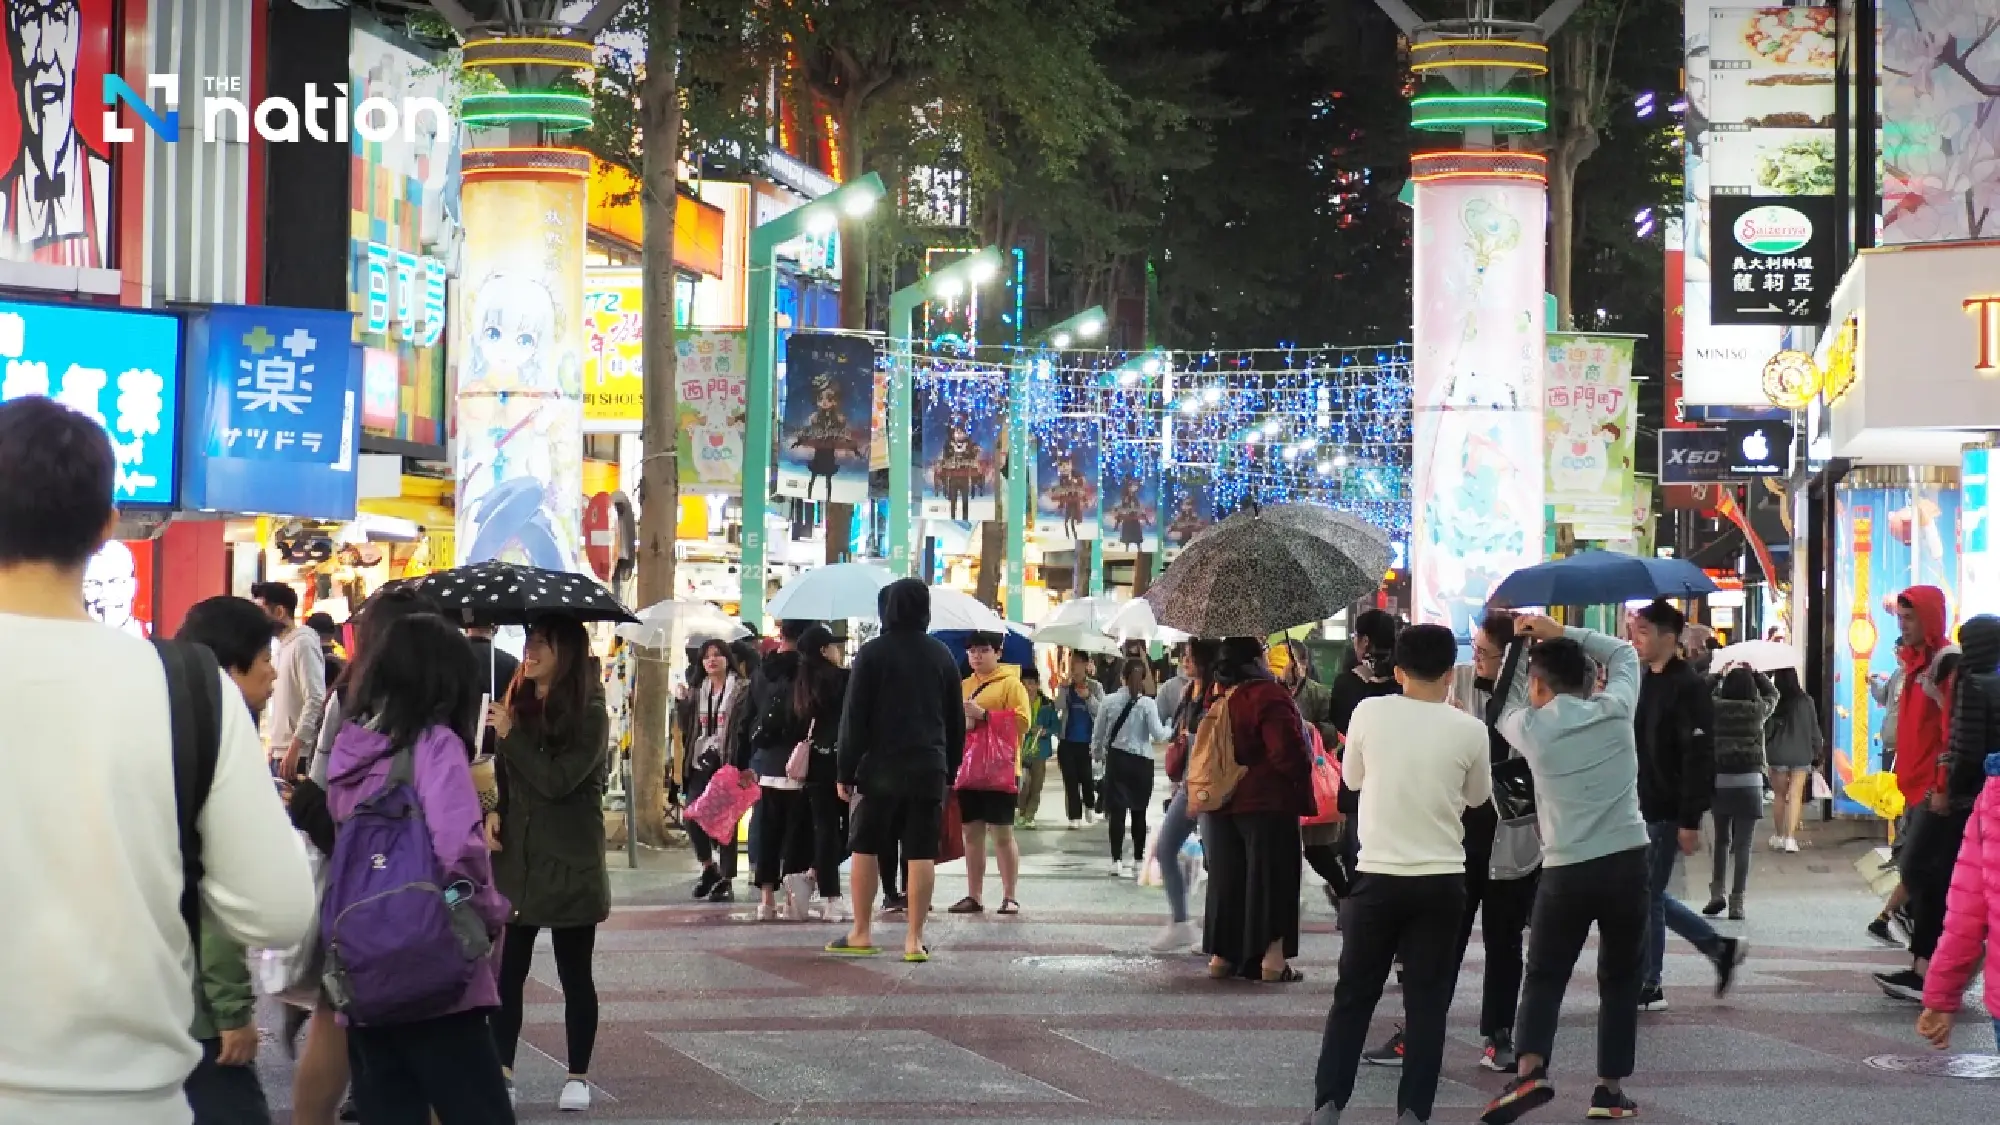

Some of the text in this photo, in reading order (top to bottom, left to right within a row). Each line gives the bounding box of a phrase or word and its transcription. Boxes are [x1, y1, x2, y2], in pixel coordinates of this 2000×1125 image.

[1548, 386, 1624, 414] 西門町
[221, 428, 323, 453] サツドラ
[747, 533, 759, 549] E
[742, 566, 763, 580] 22
